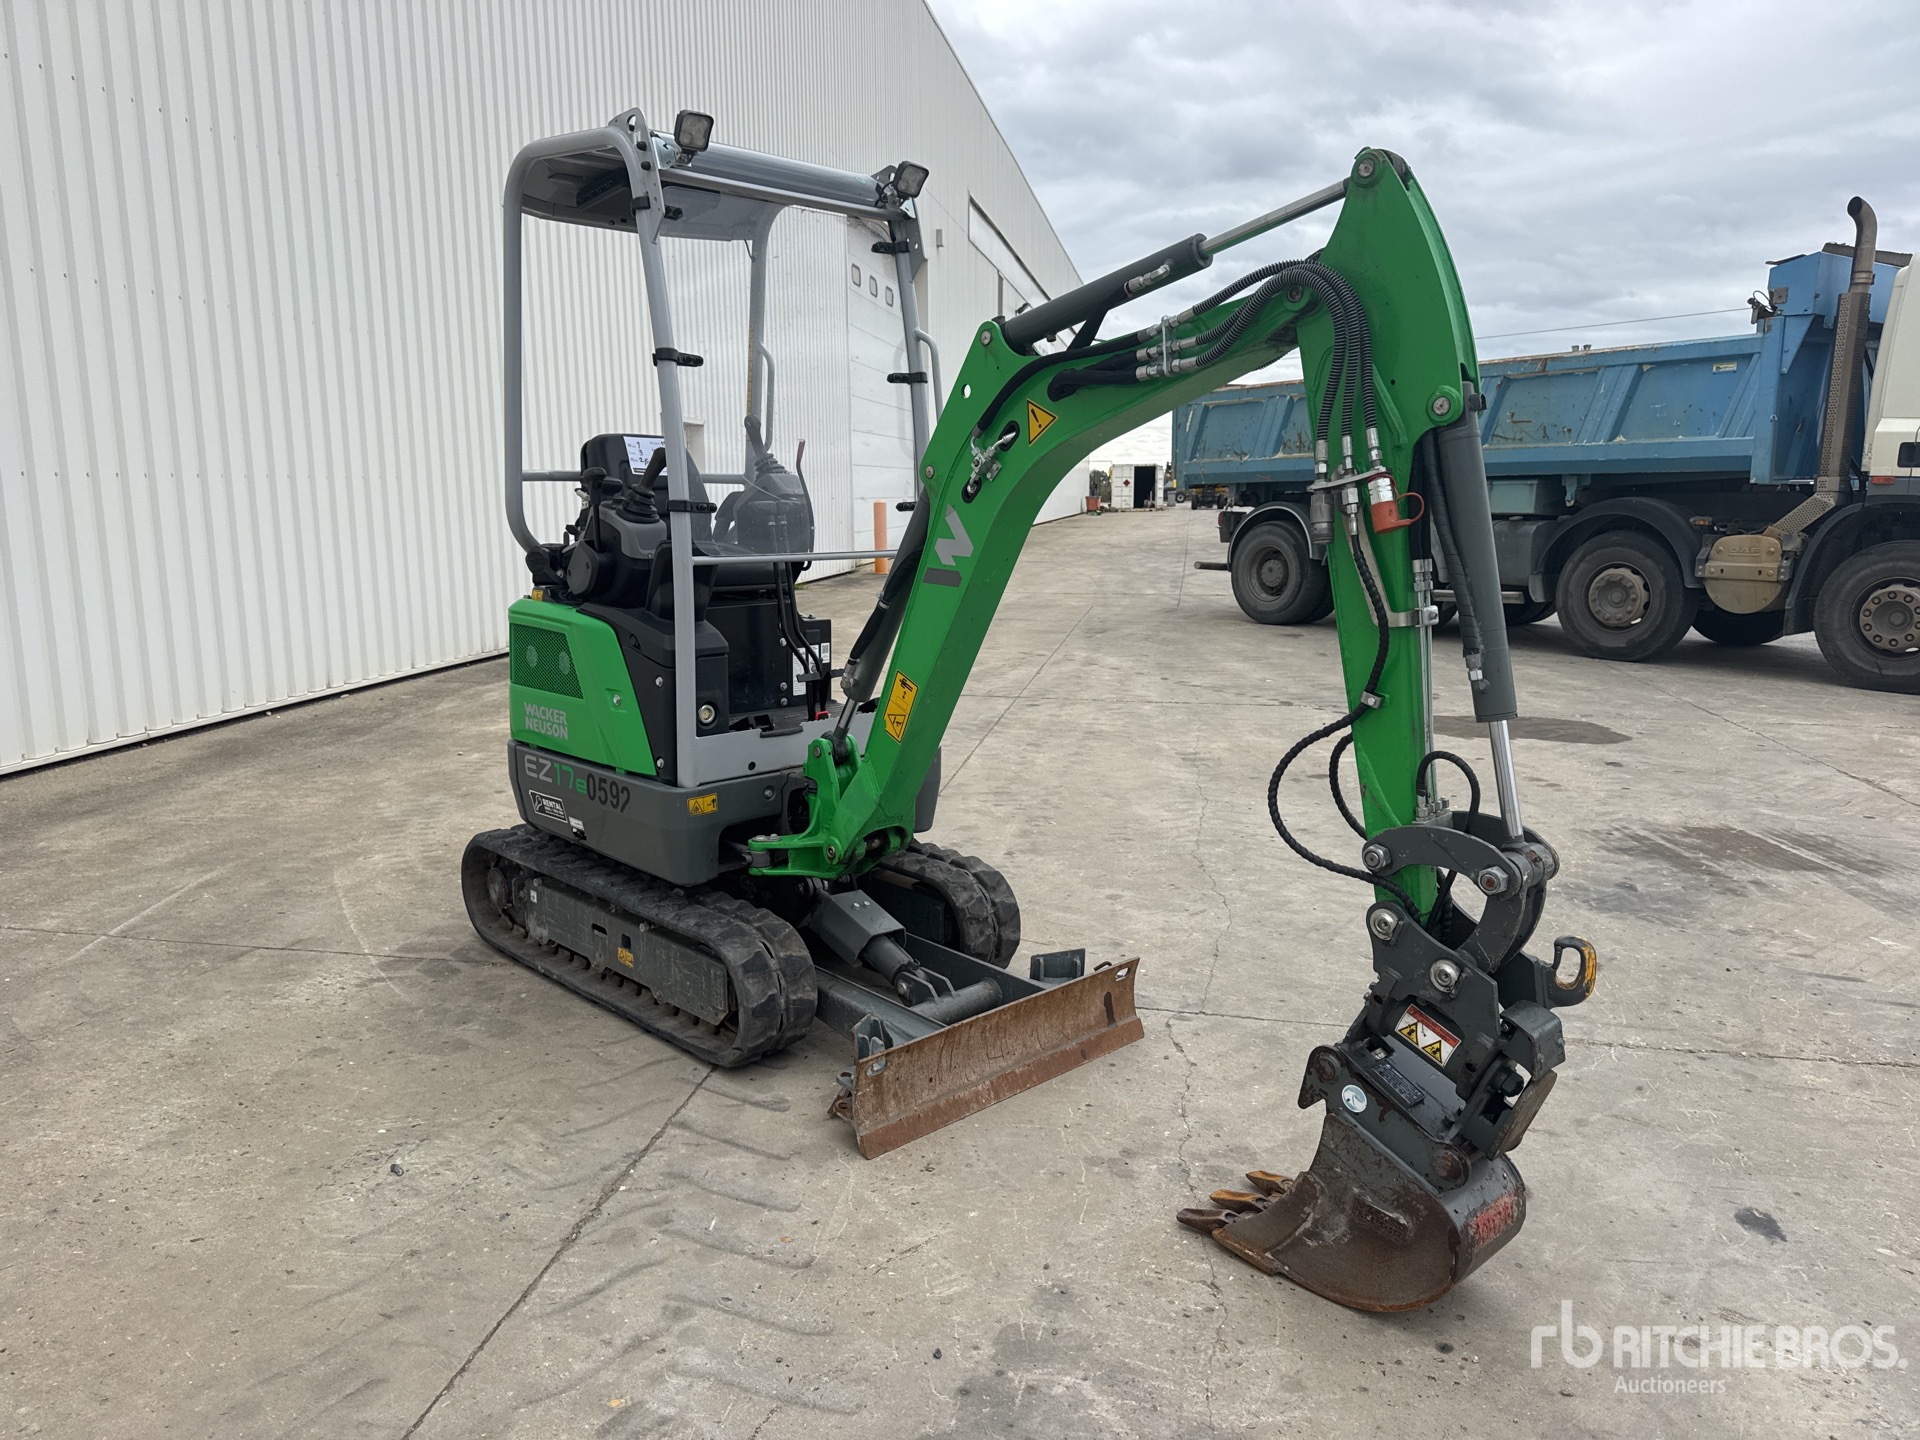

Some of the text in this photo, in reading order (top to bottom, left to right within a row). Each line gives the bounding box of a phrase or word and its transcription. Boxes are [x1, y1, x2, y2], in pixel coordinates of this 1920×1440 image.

[1728, 546, 1761, 554] DAF
[523, 701, 568, 726] WACKER
[525, 716, 568, 740] NEUSON
